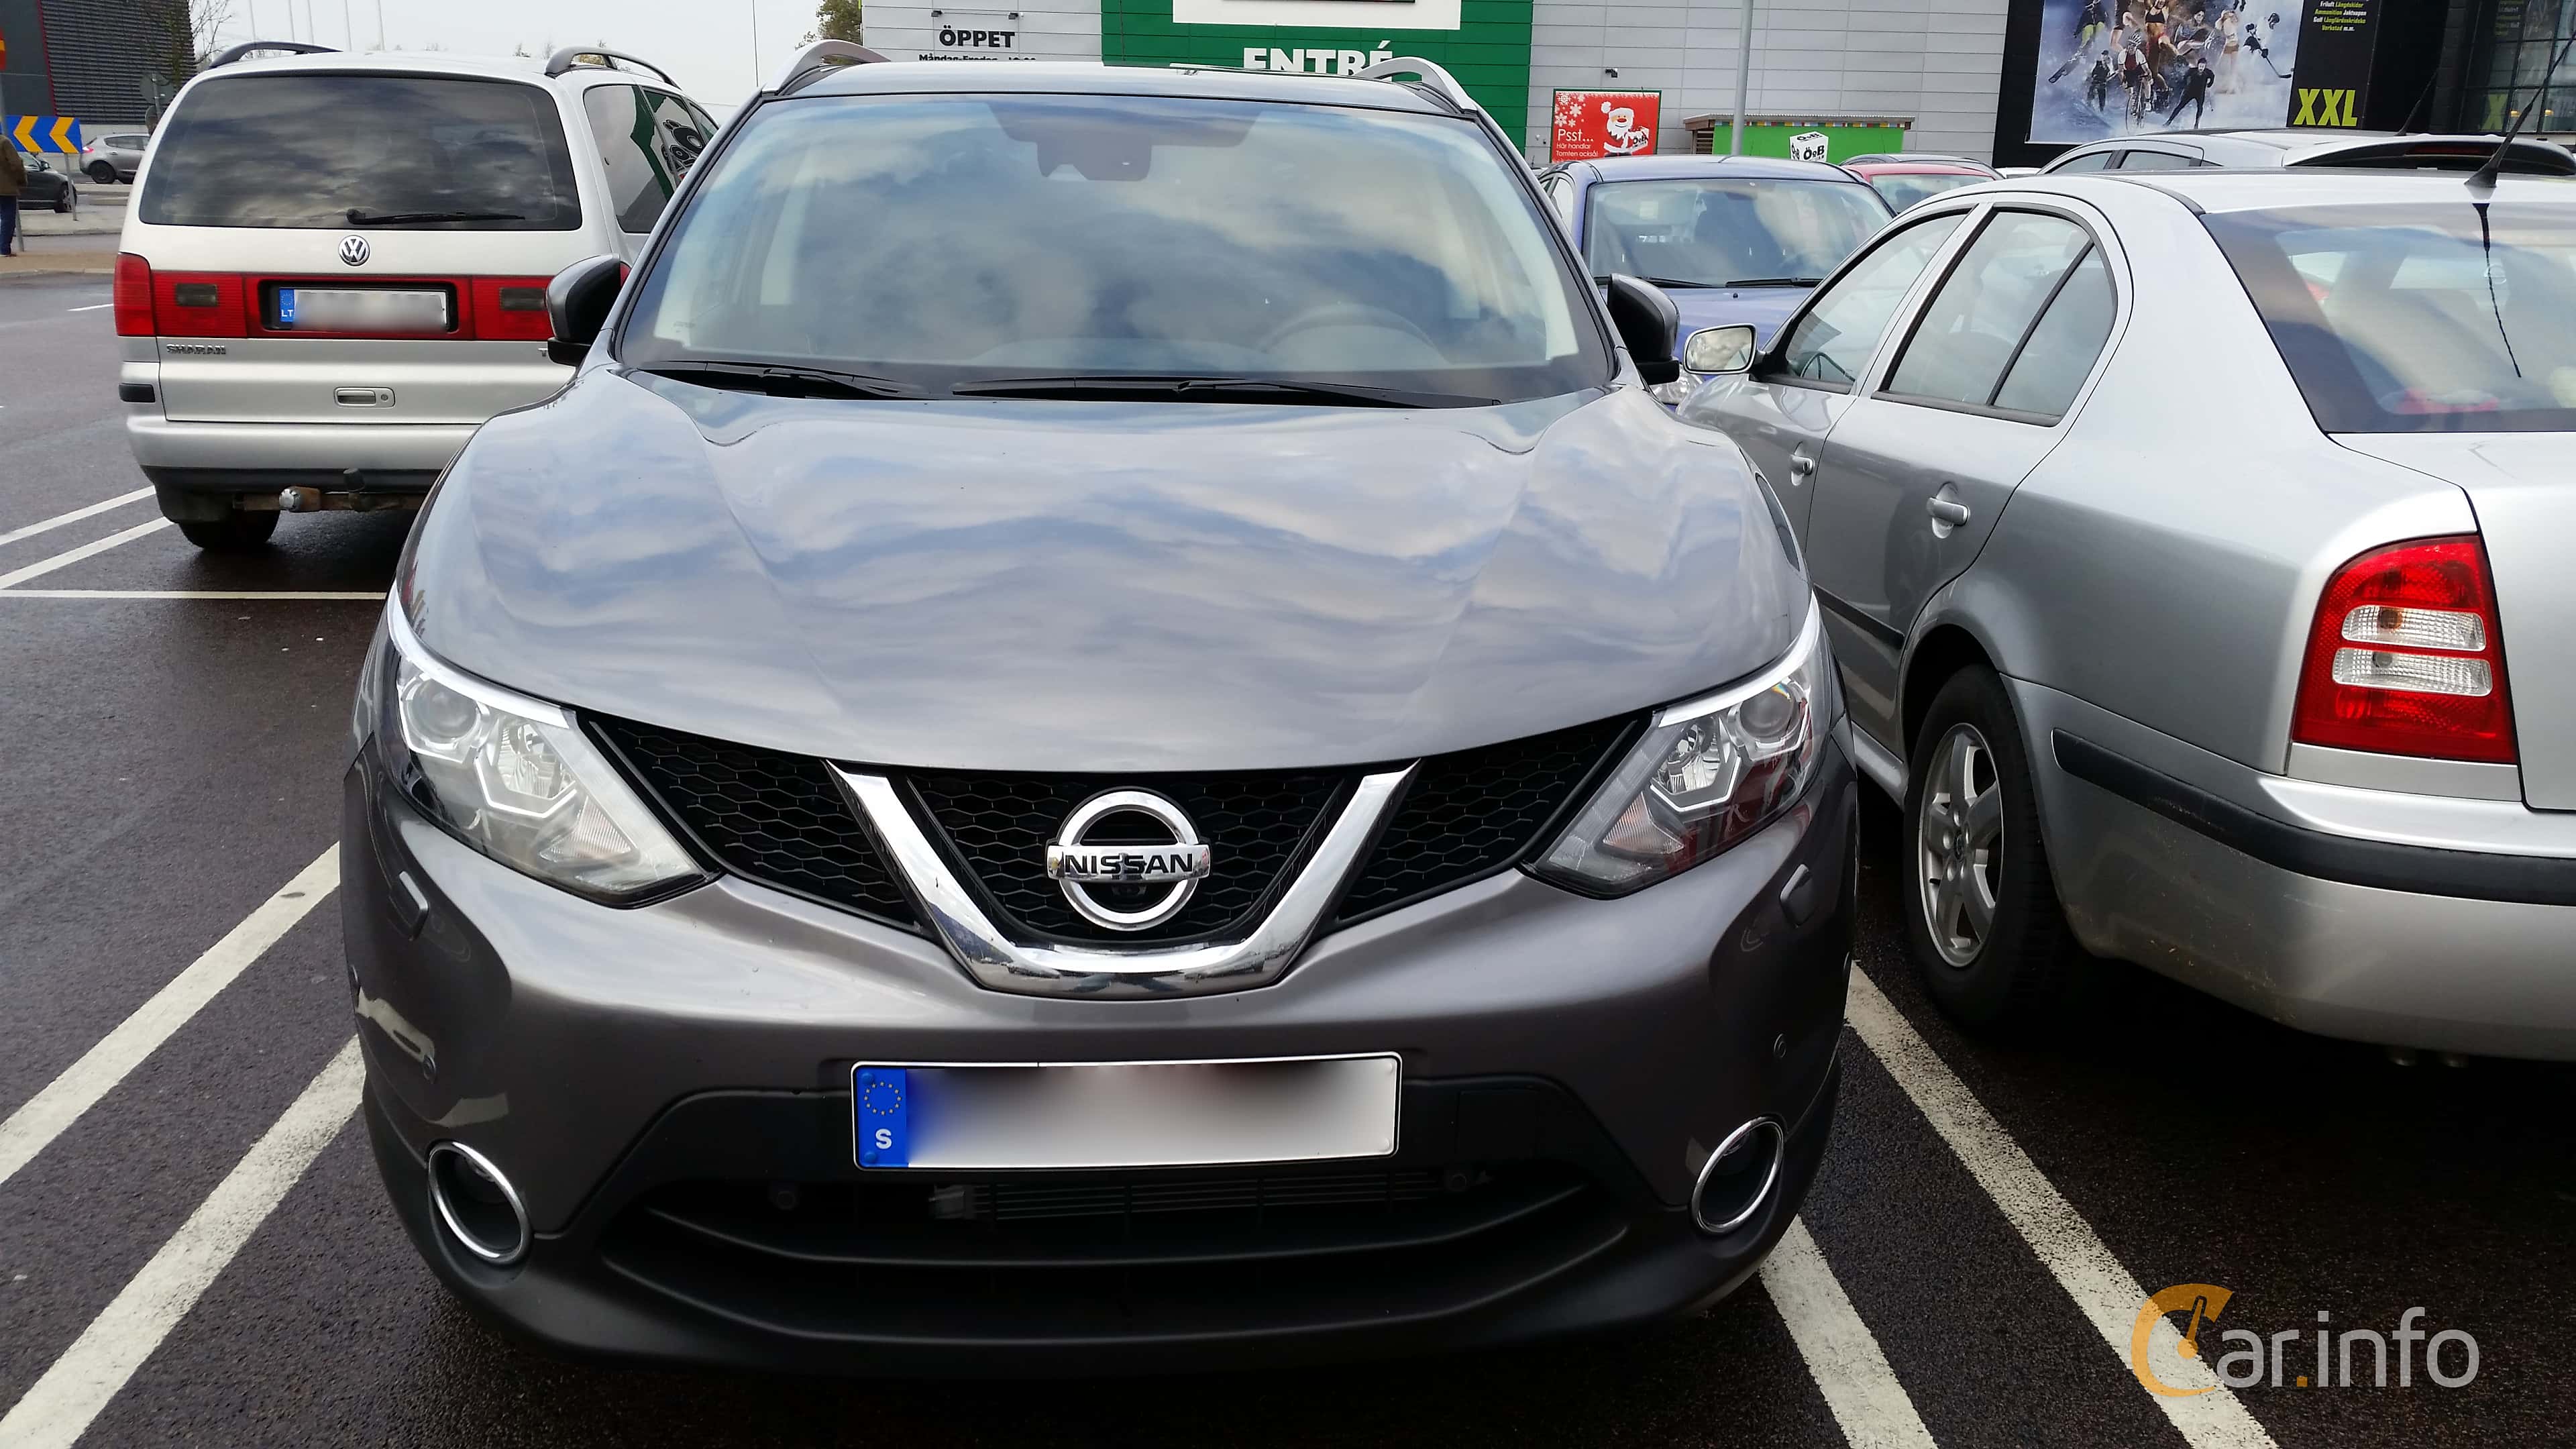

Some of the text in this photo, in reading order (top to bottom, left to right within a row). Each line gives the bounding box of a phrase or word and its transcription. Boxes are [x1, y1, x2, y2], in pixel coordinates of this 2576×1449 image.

[939, 25, 1015, 48] ÖPPET
[1243, 40, 1393, 79] ENTRÉ
[2293, 89, 2358, 126] XXL
[1558, 129, 1594, 142] Psst...
[281, 309, 294, 317] LT
[166, 344, 226, 354] SHARAN
[1065, 853, 1193, 874] NISSAN
[875, 1128, 892, 1149] S
